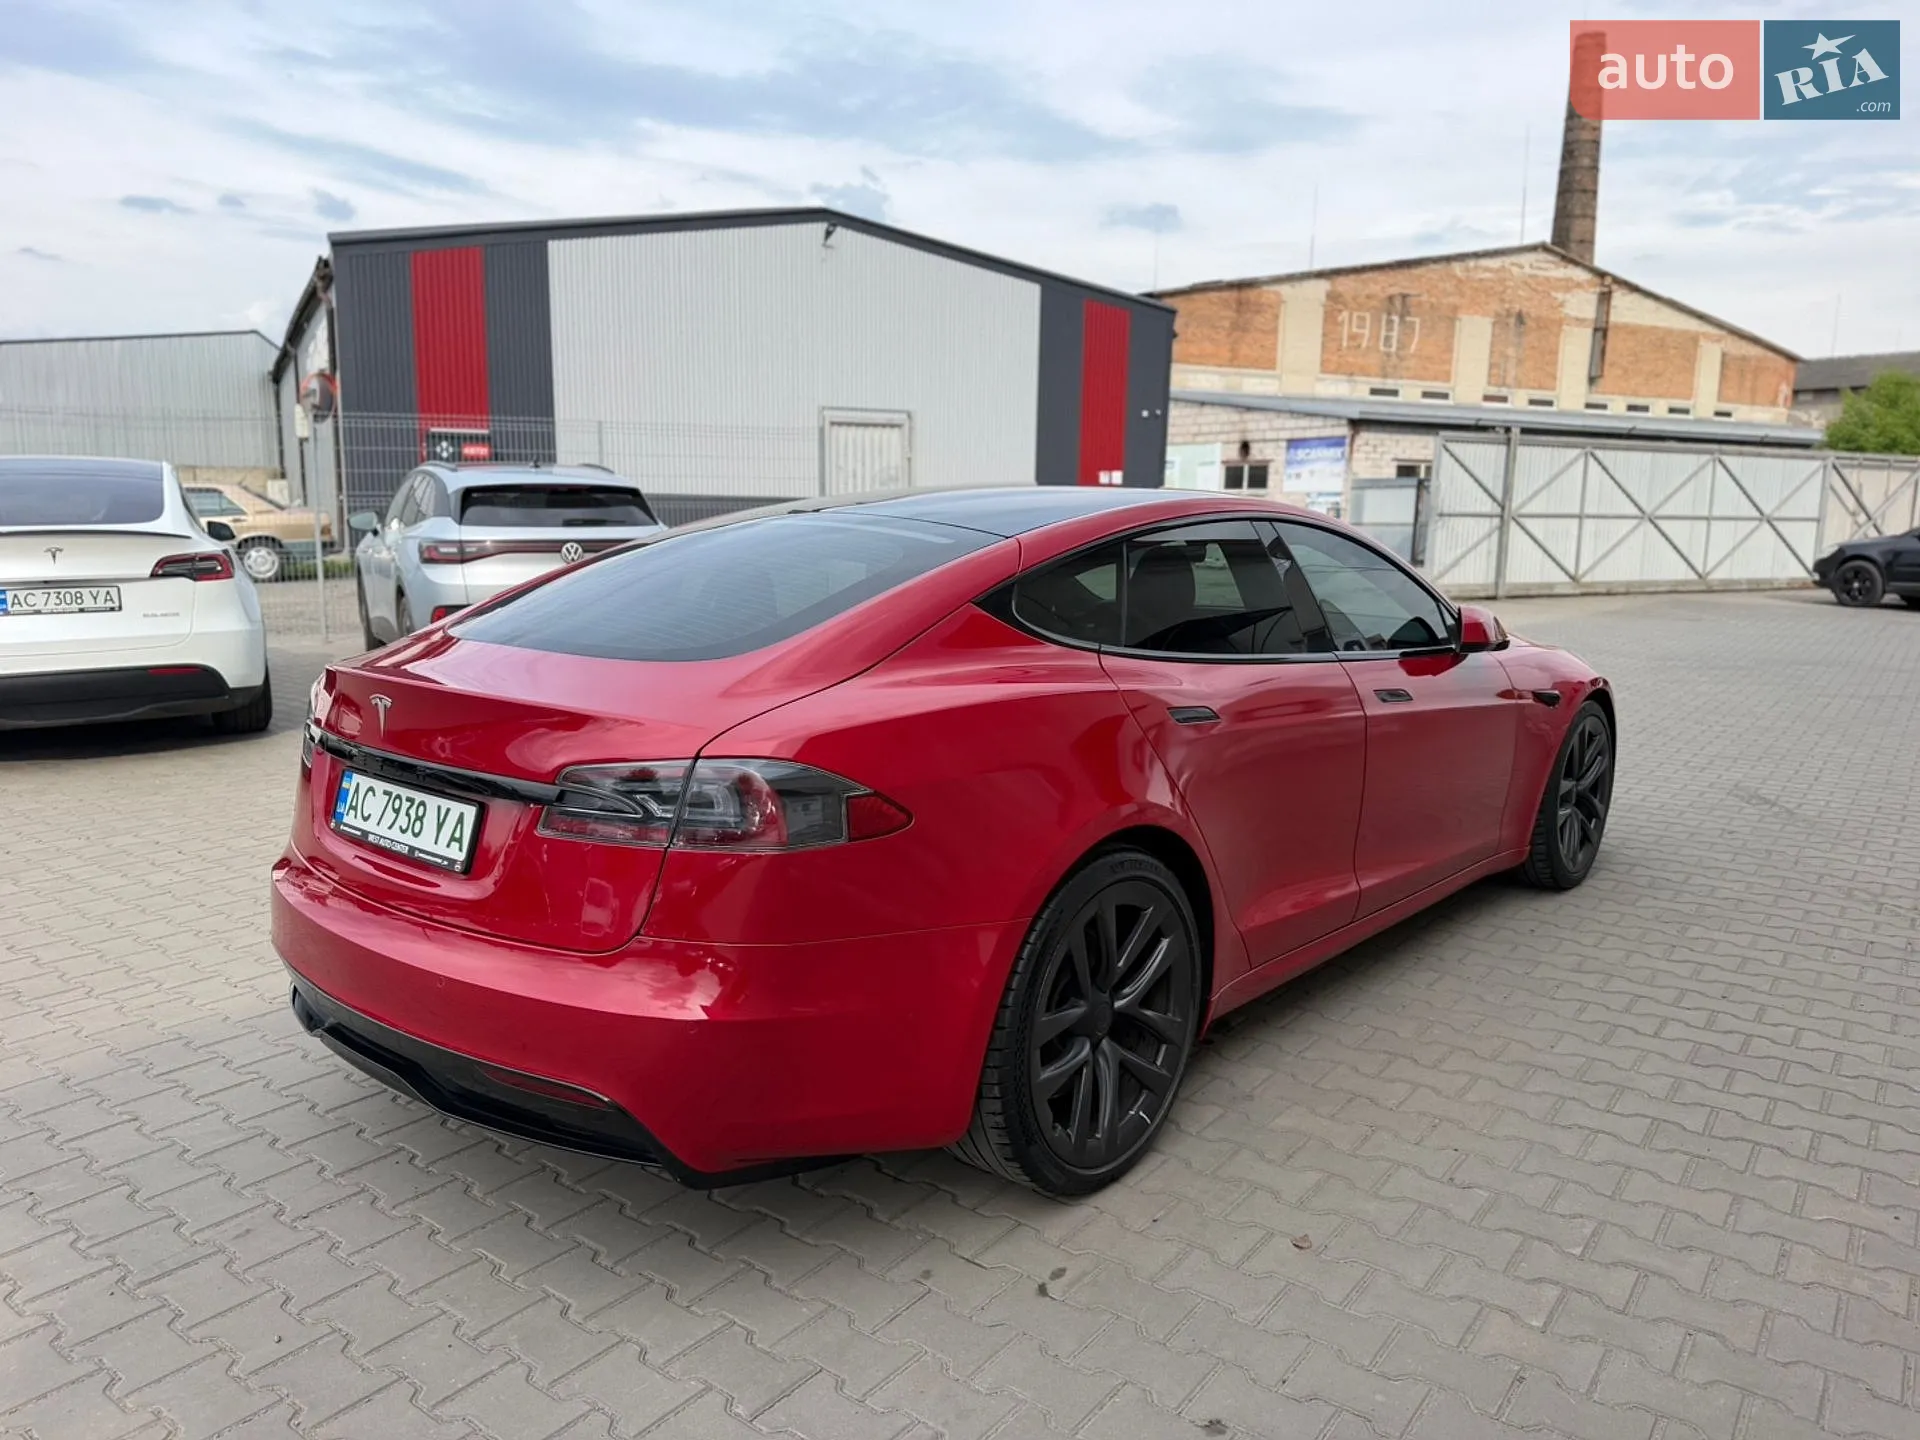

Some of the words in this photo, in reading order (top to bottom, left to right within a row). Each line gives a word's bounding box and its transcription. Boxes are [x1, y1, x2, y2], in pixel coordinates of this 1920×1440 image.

[1337, 310, 1421, 354] 1987
[10, 592, 37, 609] AC
[41, 590, 84, 607] 7308
[89, 589, 116, 606] YA
[346, 782, 376, 823] AC
[376, 789, 427, 838] 7938
[434, 804, 465, 852] YA
